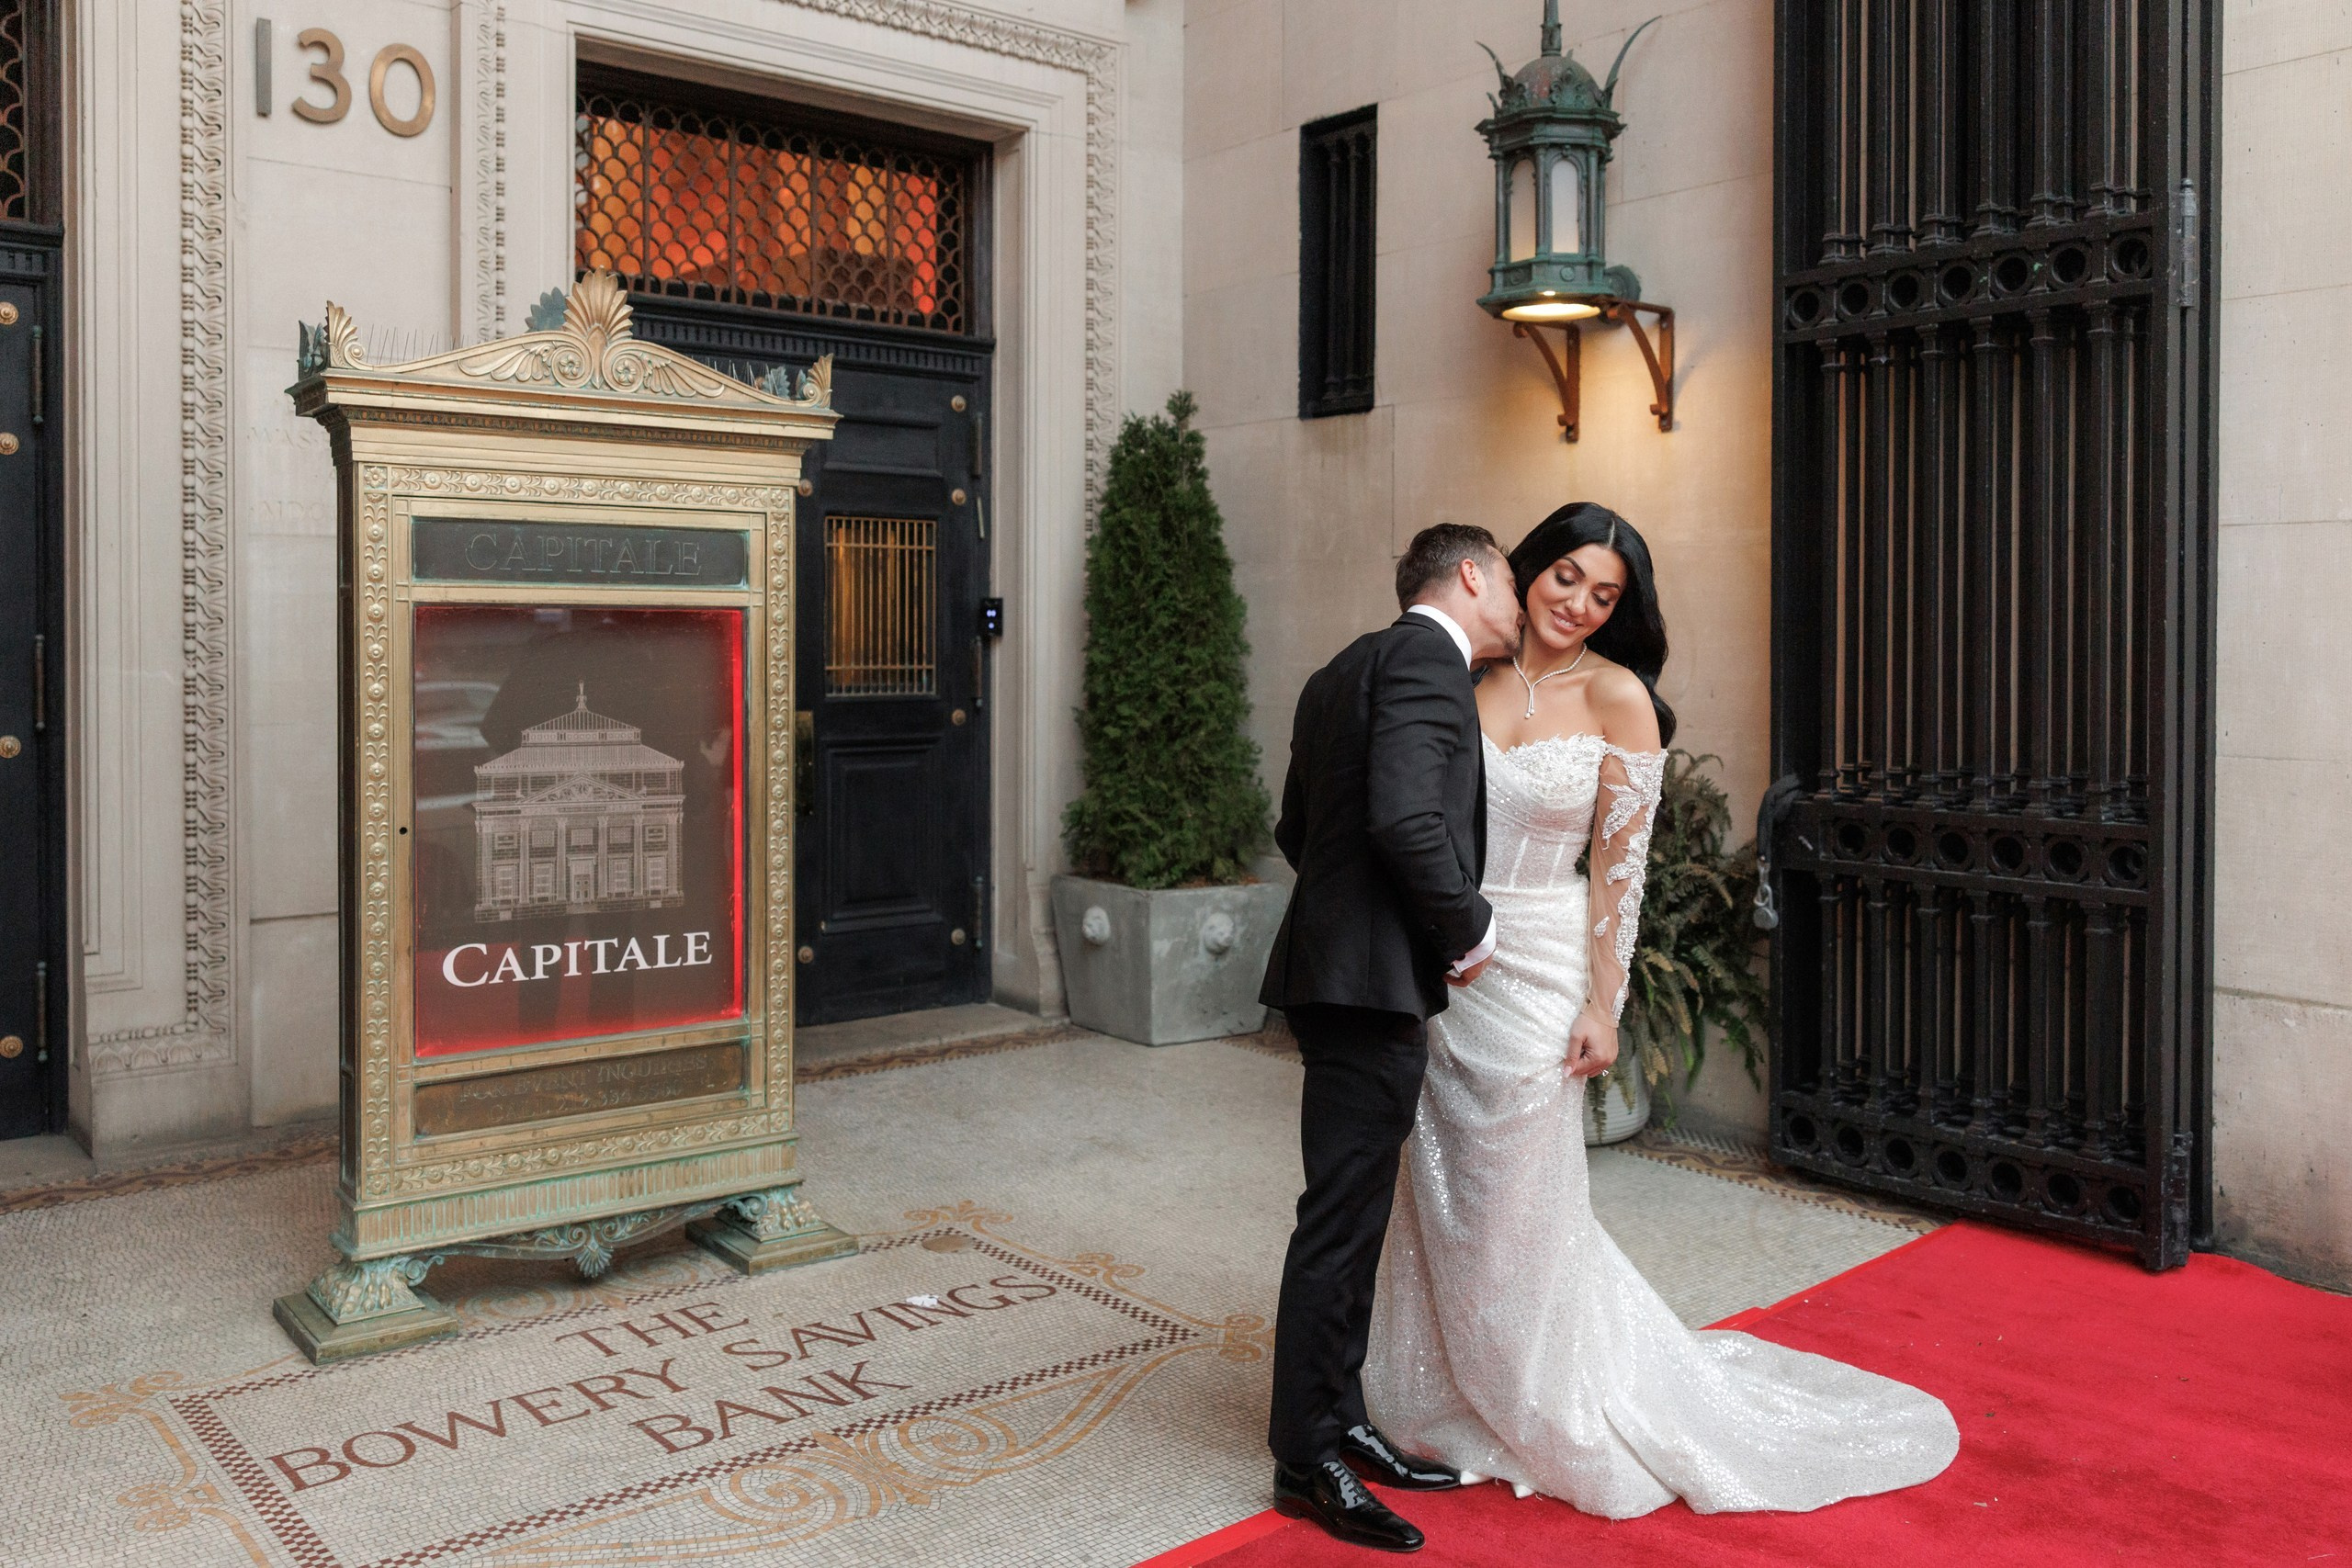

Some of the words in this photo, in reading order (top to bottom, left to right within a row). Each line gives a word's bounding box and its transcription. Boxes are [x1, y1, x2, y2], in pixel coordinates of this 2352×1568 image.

[254, 17, 437, 138] 130
[464, 533, 703, 577] CAPITALE
[441, 931, 714, 988] CAPITALE
[555, 1300, 750, 1359] THE
[264, 1358, 690, 1493] BOWERY
[722, 1273, 1057, 1372] SAVINGS
[628, 1359, 912, 1455] BANK
